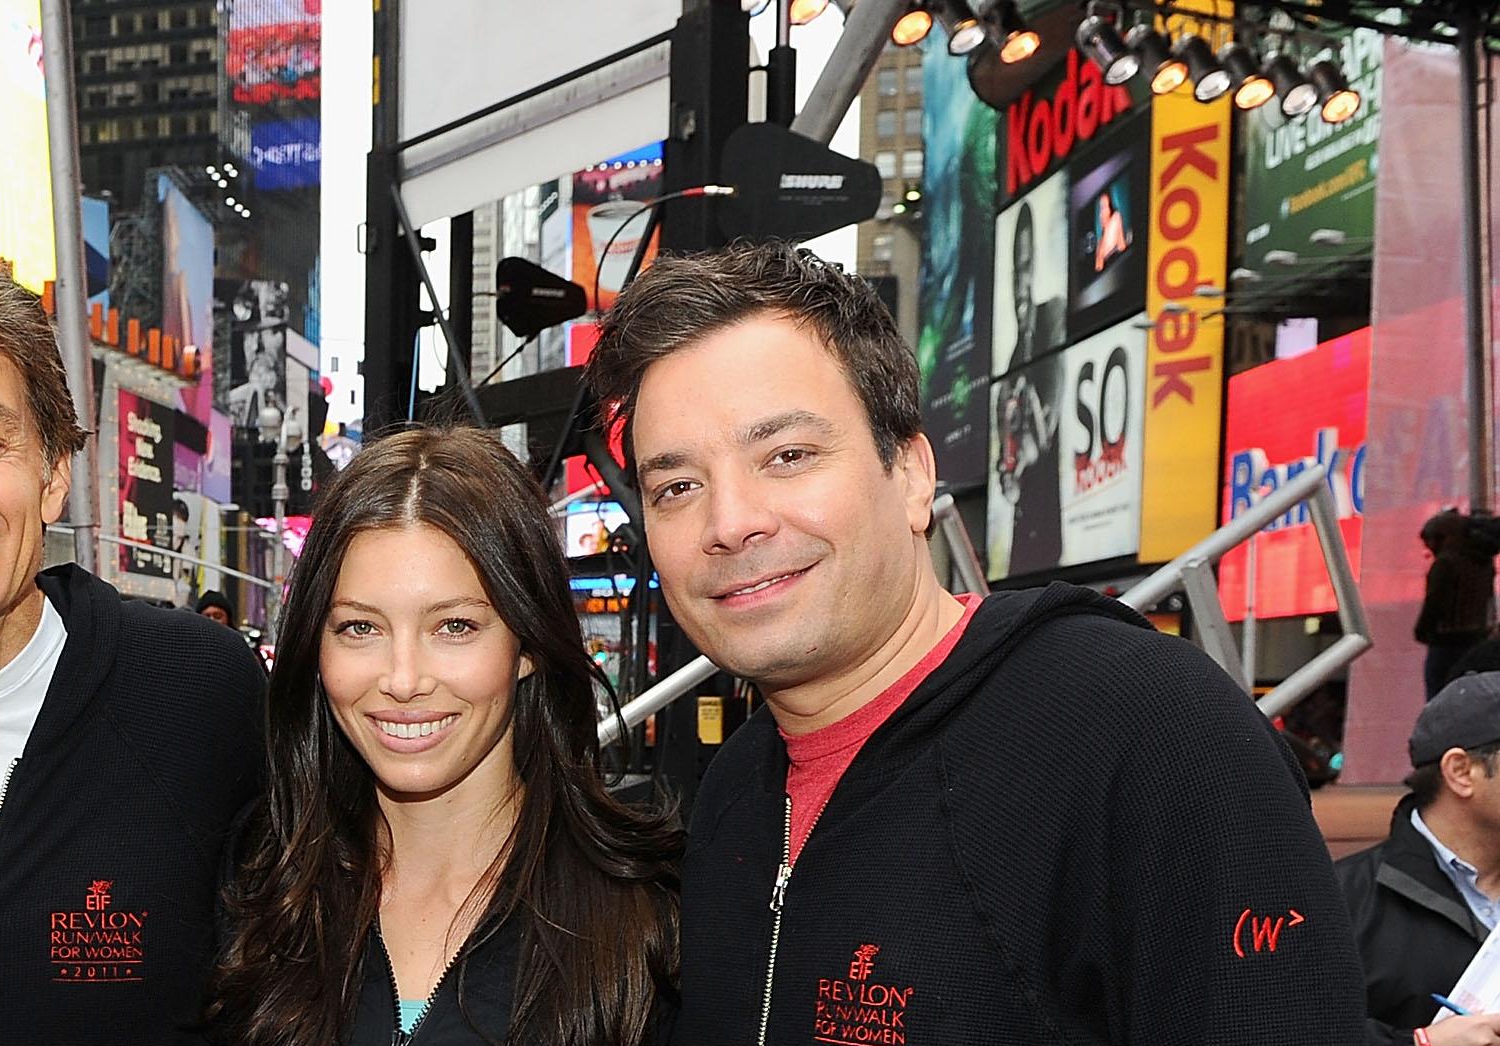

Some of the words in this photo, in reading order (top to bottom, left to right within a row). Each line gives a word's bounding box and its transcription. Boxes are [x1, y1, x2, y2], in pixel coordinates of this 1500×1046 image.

[1152, 122, 1220, 411] Kodak
[86, 894, 111, 910] EIF
[51, 912, 143, 929] REVLON
[51, 930, 141, 944] RUN/WALK
[51, 946, 80, 958] FOR
[84, 946, 143, 958] WOMEN
[74, 966, 118, 978] 2011
[849, 961, 874, 980] EIF
[819, 979, 908, 1008] REVLON
[815, 1019, 837, 1035] FOR
[841, 1024, 905, 1045] WOMEN
